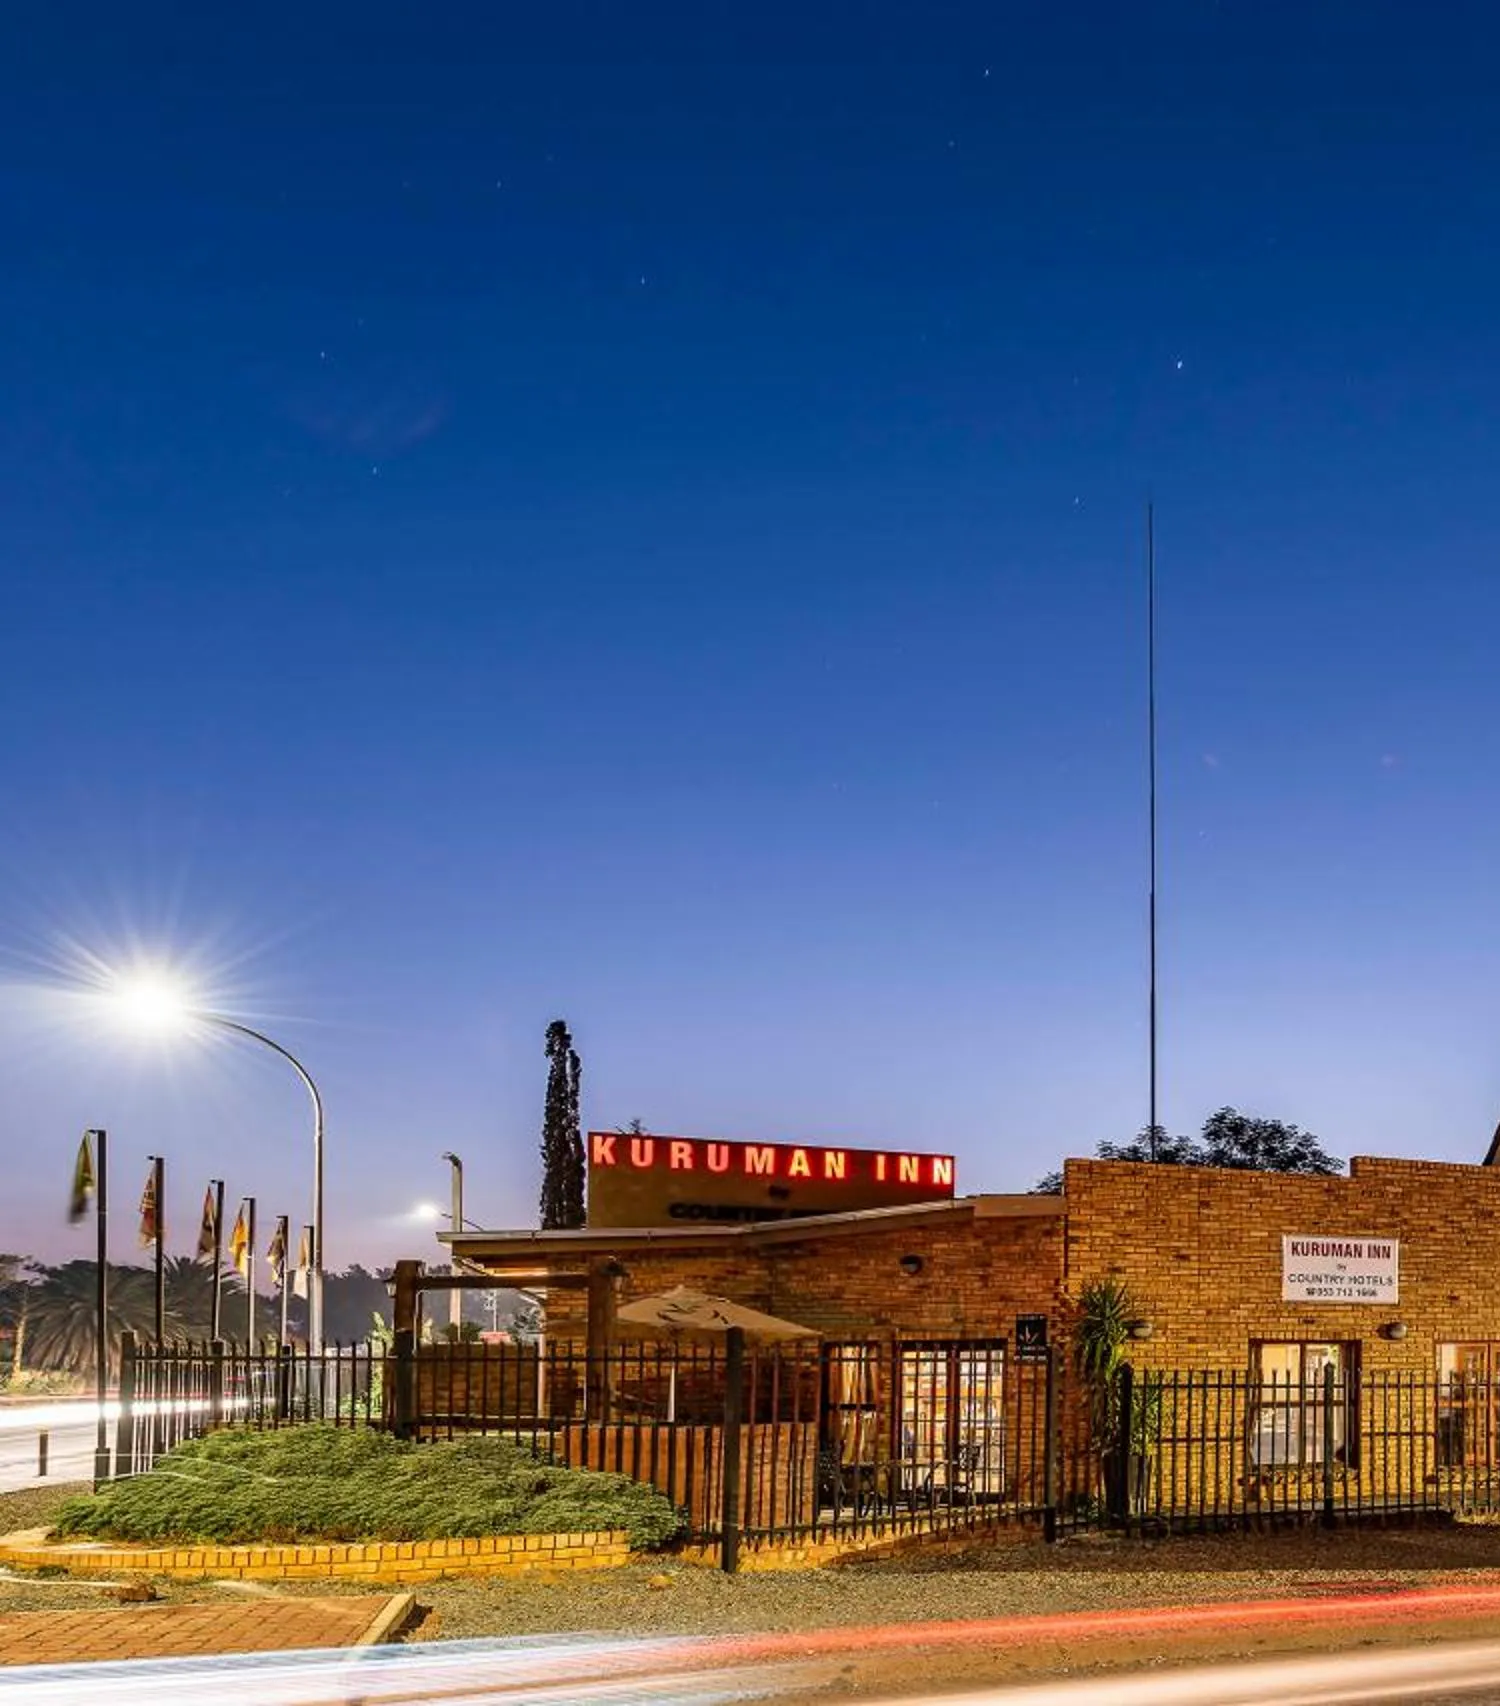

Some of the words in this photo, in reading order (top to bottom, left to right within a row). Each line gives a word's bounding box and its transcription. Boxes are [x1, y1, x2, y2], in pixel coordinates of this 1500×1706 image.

[593, 1135, 846, 1178] KURUMAN
[877, 1155, 953, 1185] INN
[1291, 1241, 1362, 1258] KURUMAN
[1368, 1244, 1391, 1259] INN
[1288, 1273, 1346, 1285] COUNTRY
[1349, 1275, 1393, 1286] HOTELS
